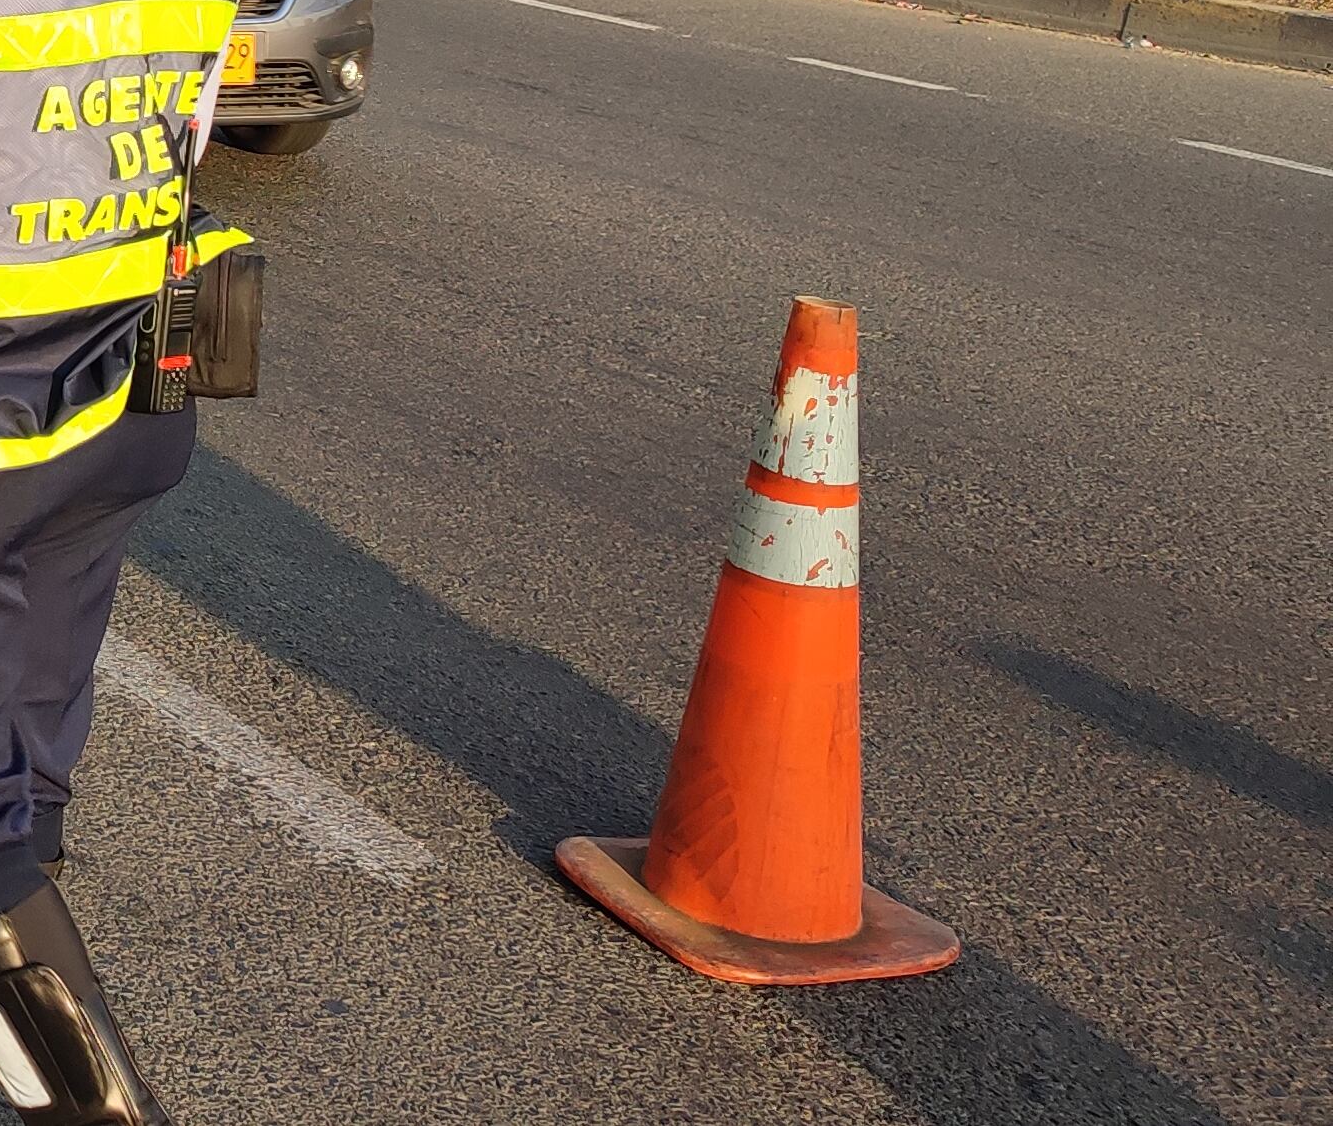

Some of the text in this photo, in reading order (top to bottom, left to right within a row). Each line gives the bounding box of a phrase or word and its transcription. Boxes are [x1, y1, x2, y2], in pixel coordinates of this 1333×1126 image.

[37, 71, 205, 132] AGENTE
[109, 124, 173, 181] DE
[11, 176, 182, 244] TRANS
